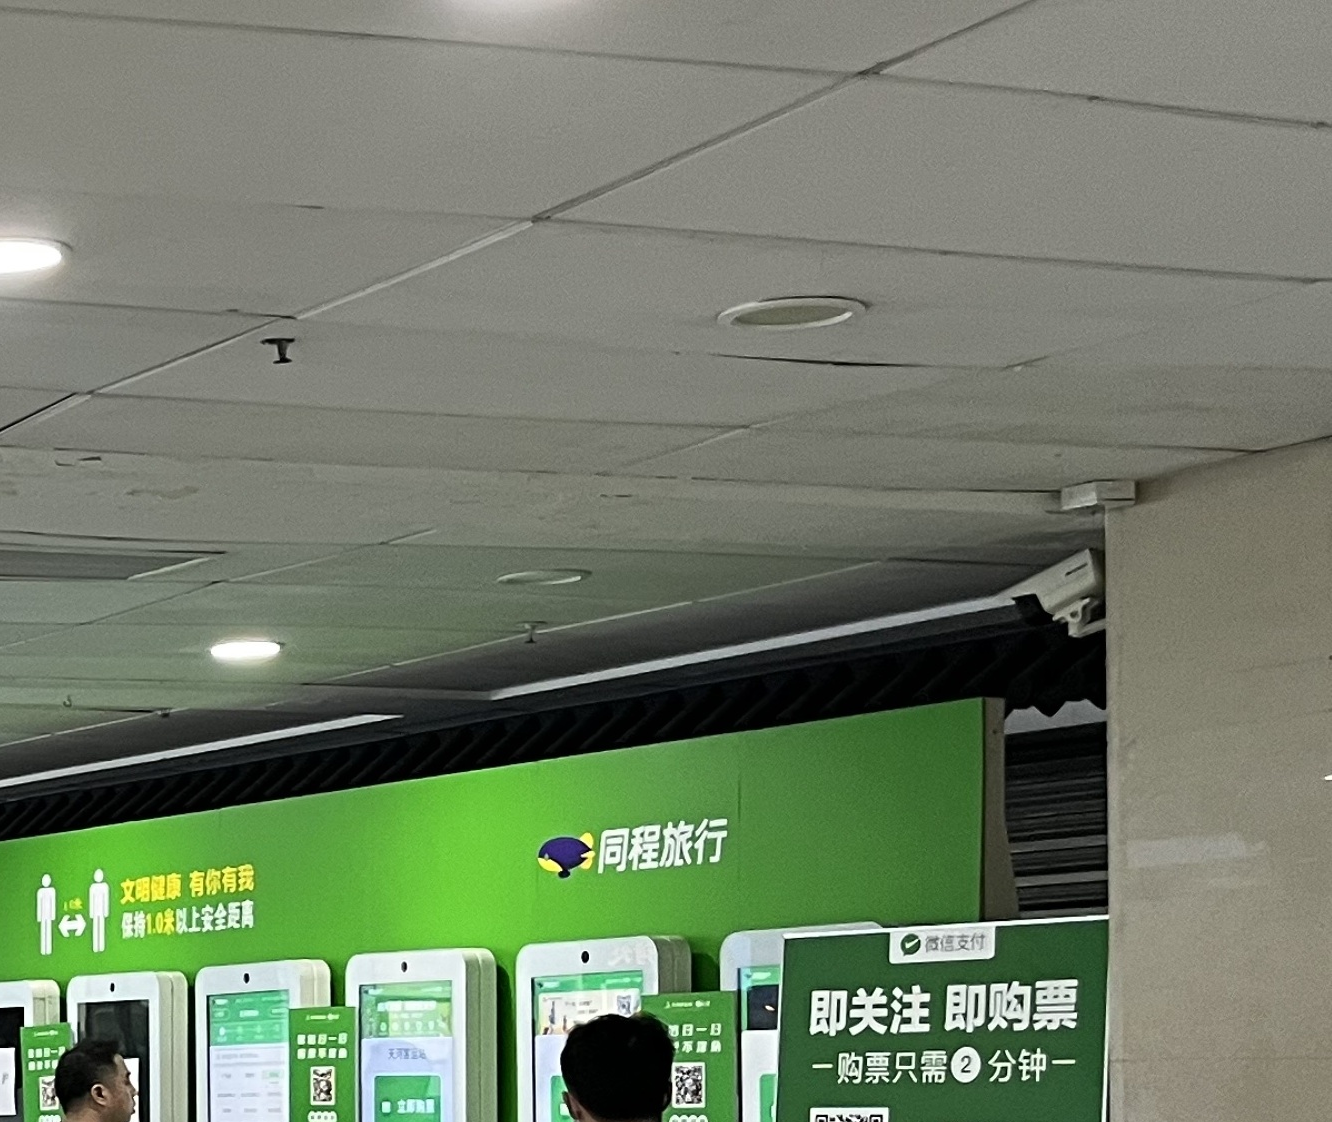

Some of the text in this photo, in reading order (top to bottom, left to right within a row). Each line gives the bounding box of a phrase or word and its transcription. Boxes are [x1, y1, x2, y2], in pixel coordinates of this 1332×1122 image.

[597, 818, 728, 875] 同程旅行
[120, 863, 255, 905] 文明健康 有你有我
[121, 899, 254, 939] 保持1.0米以上安全距离
[925, 933, 986, 953] 微信支付
[809, 978, 1079, 1037] 即关注 即购票
